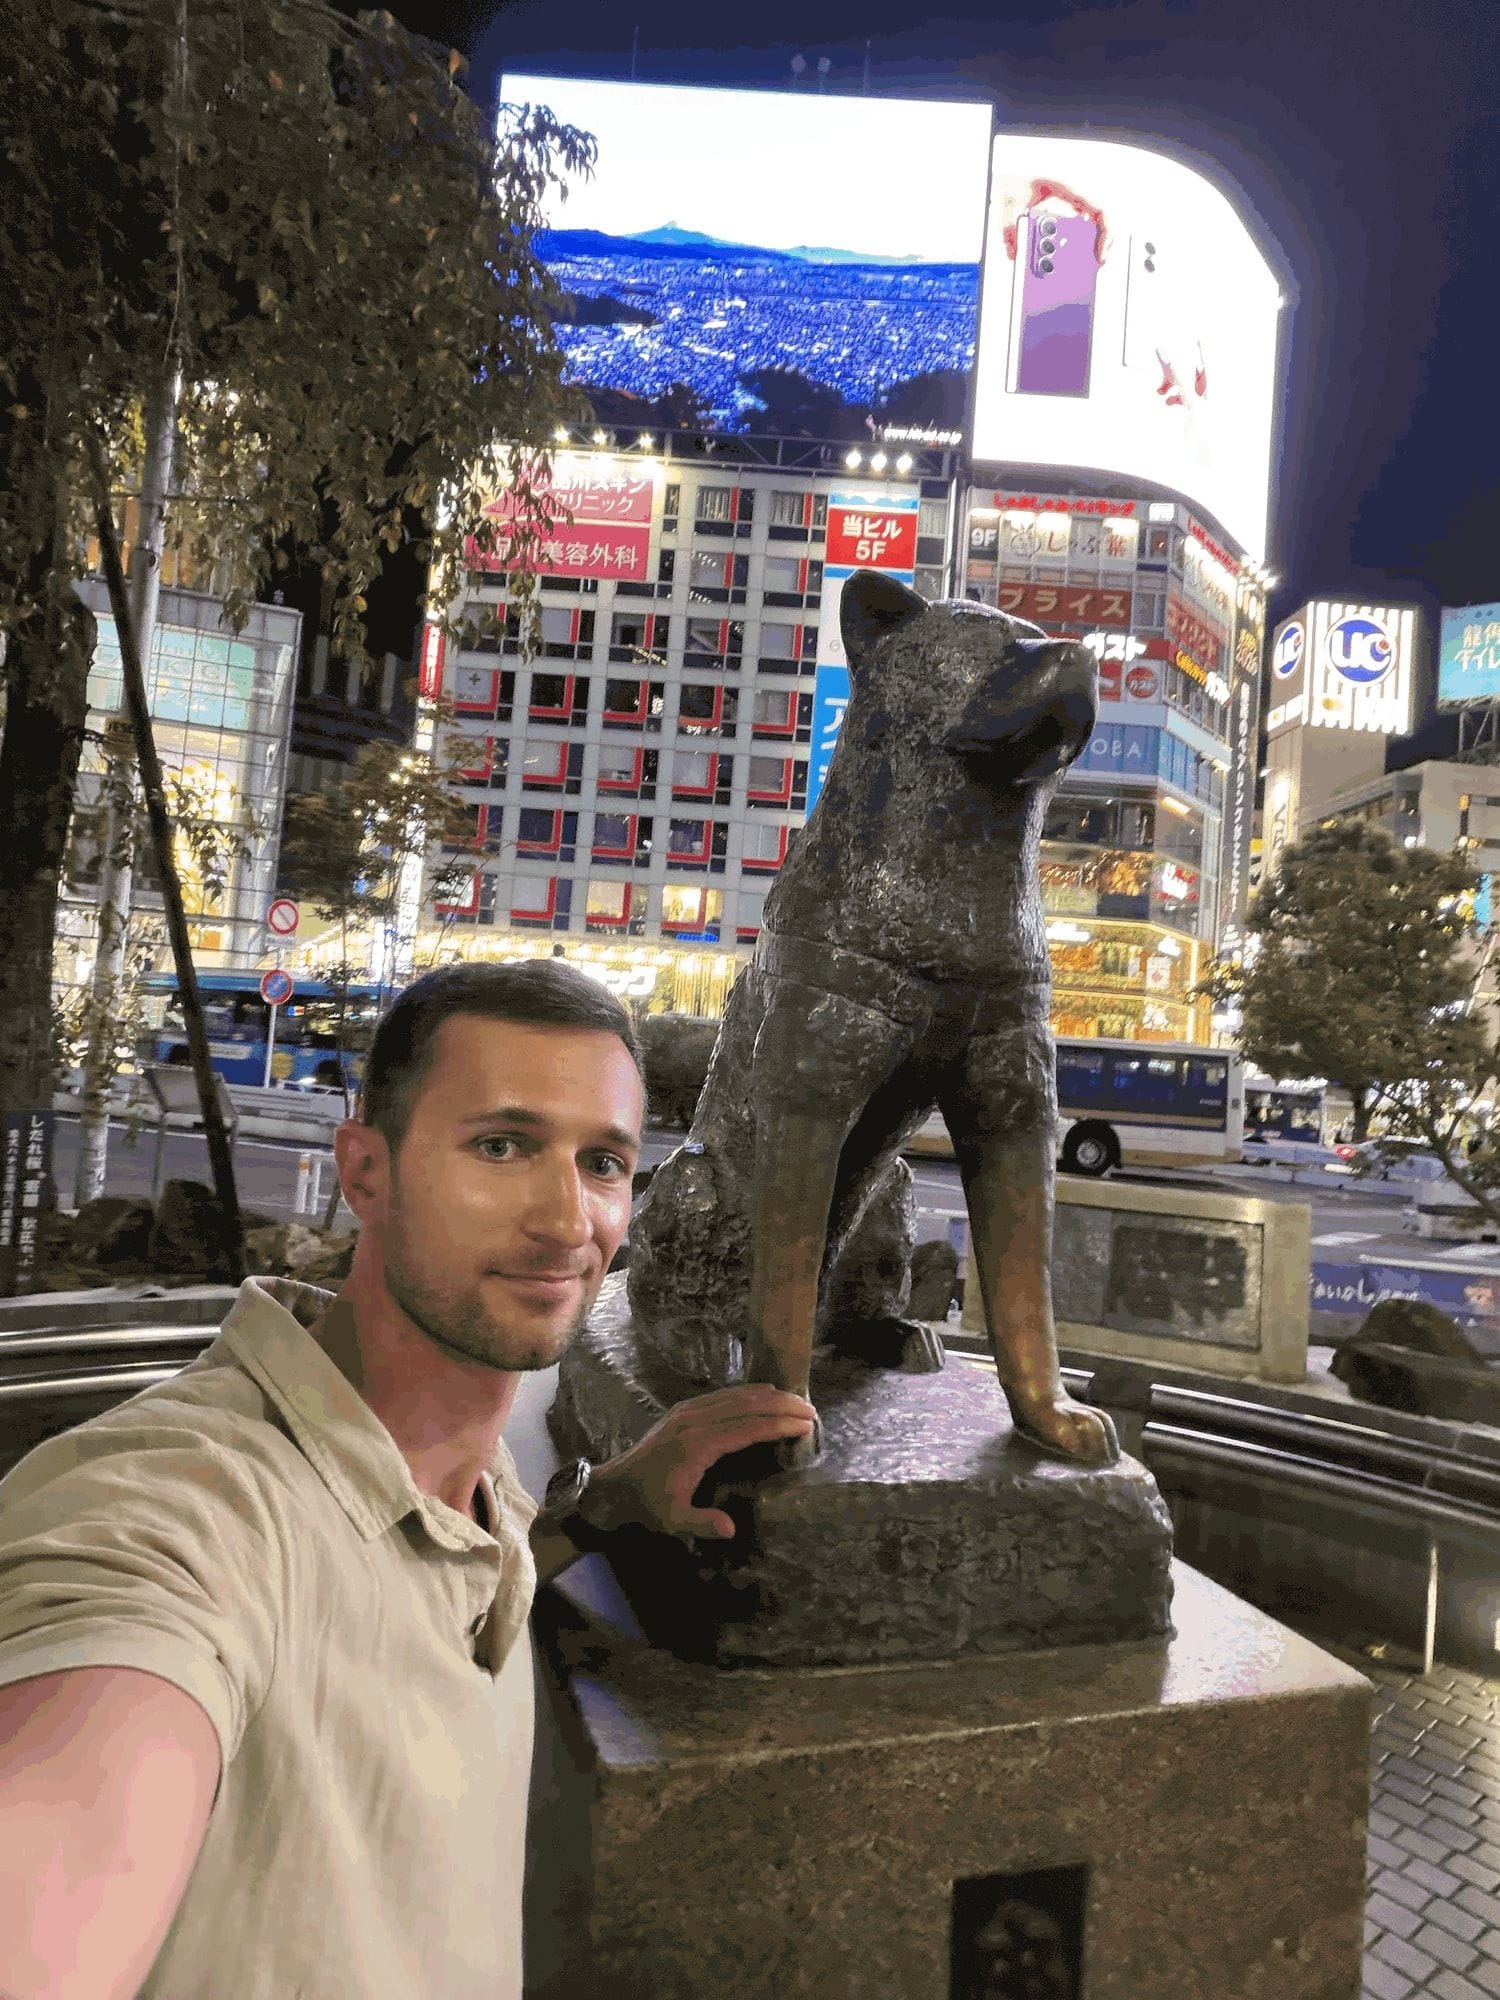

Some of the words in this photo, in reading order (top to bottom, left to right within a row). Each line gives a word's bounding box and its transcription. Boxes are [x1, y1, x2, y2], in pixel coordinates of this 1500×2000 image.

[556, 491, 634, 515] クリニック
[842, 514, 903, 540] 当ビル
[490, 536, 639, 572] 品川美容外科
[855, 540, 887, 561] 5F
[1082, 632, 1147, 662] ガスト
[1331, 629, 1392, 672] UC
